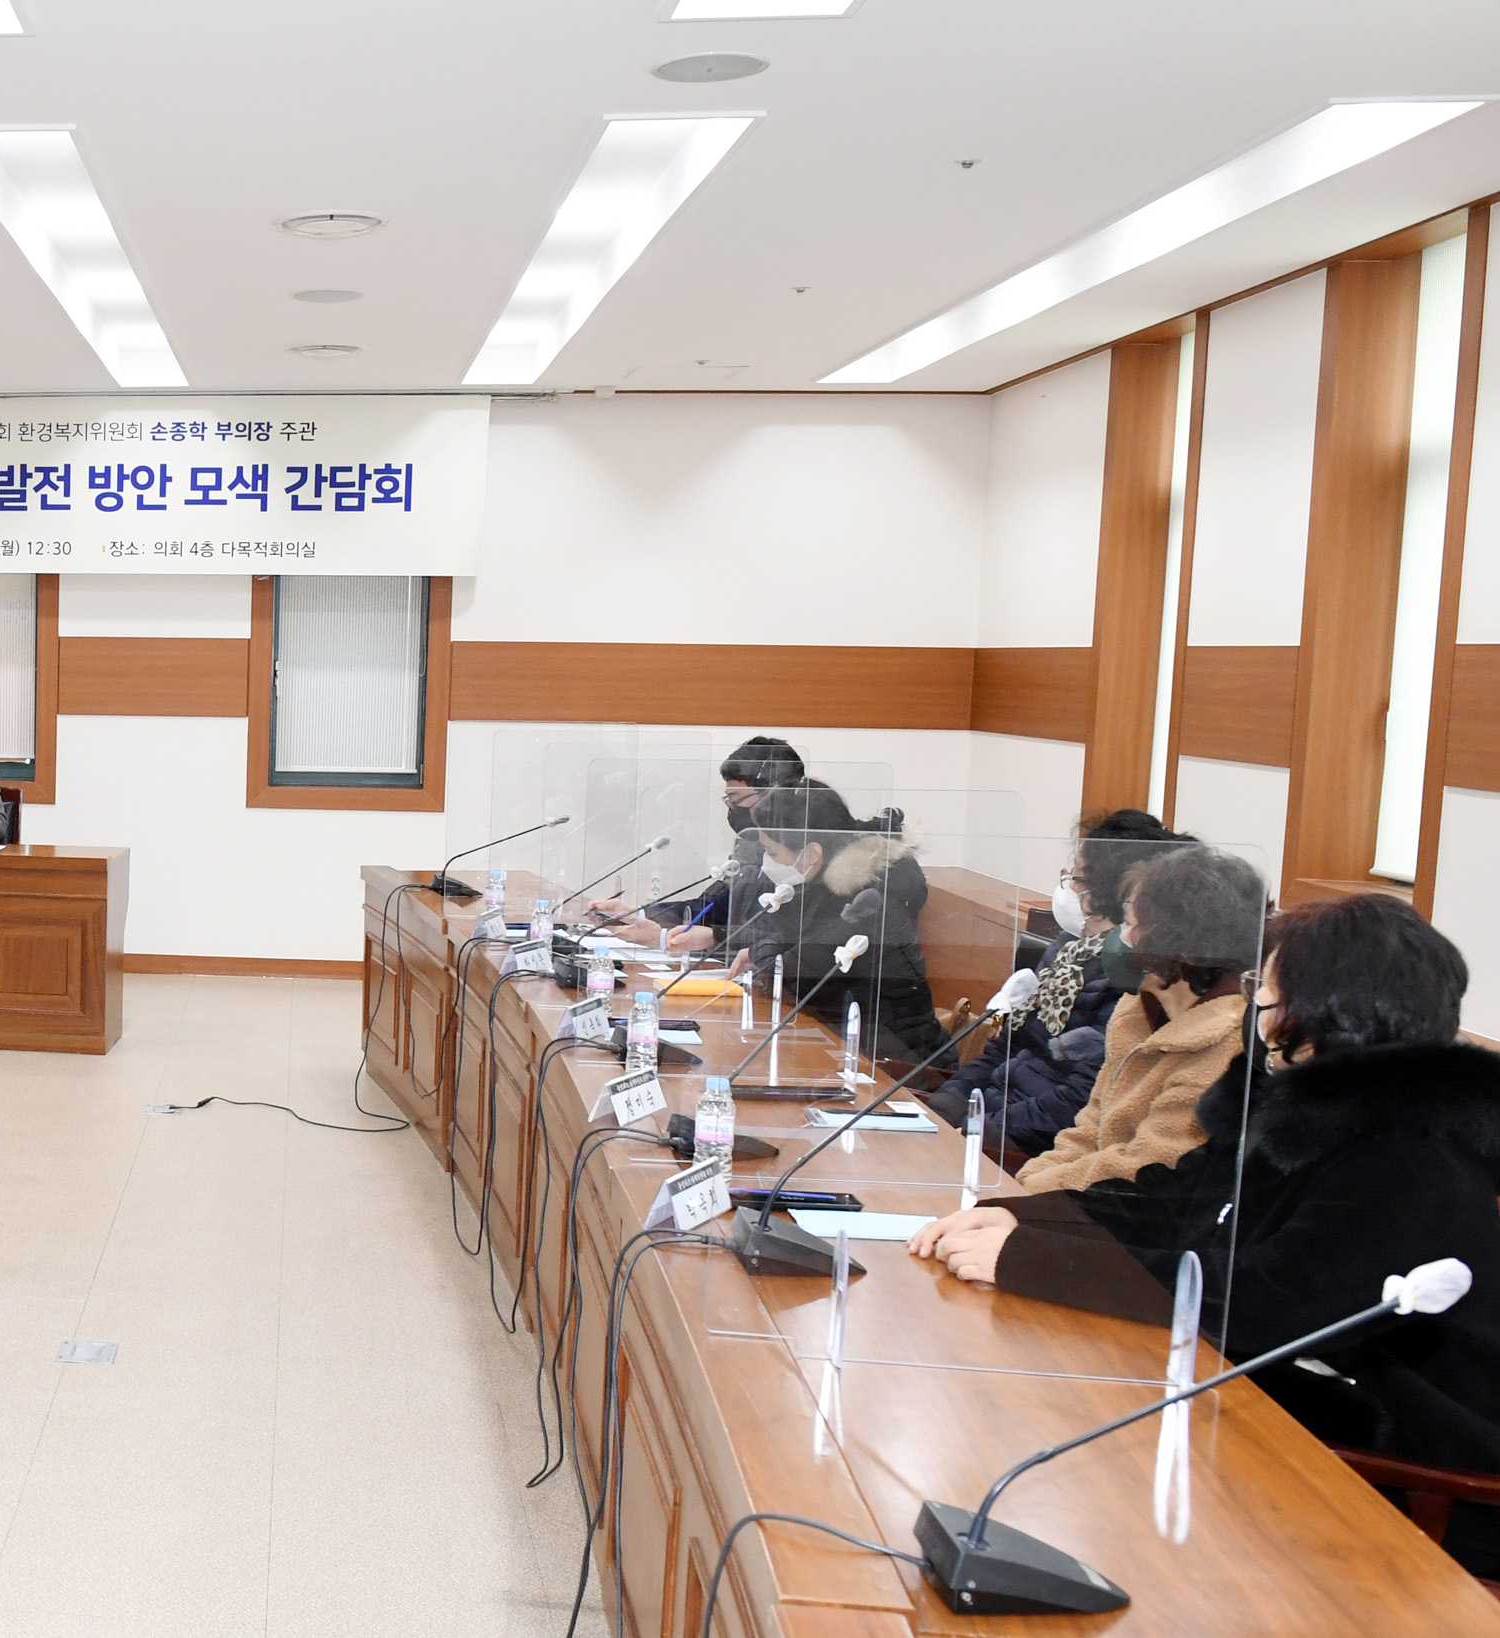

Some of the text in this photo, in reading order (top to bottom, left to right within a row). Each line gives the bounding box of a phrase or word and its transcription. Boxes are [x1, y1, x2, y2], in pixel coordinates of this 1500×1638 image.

[17, 421, 143, 443] 환경복지위원회
[149, 420, 208, 442] 손종학
[214, 420, 274, 442] 부의장
[279, 421, 318, 442] 주관
[88, 463, 173, 512] 방안
[184, 463, 269, 512] 모색
[284, 463, 414, 512] 간담회
[27, 540, 73, 556] 12:30
[109, 540, 316, 559] 장소: 의회 4층 다목적회의실
